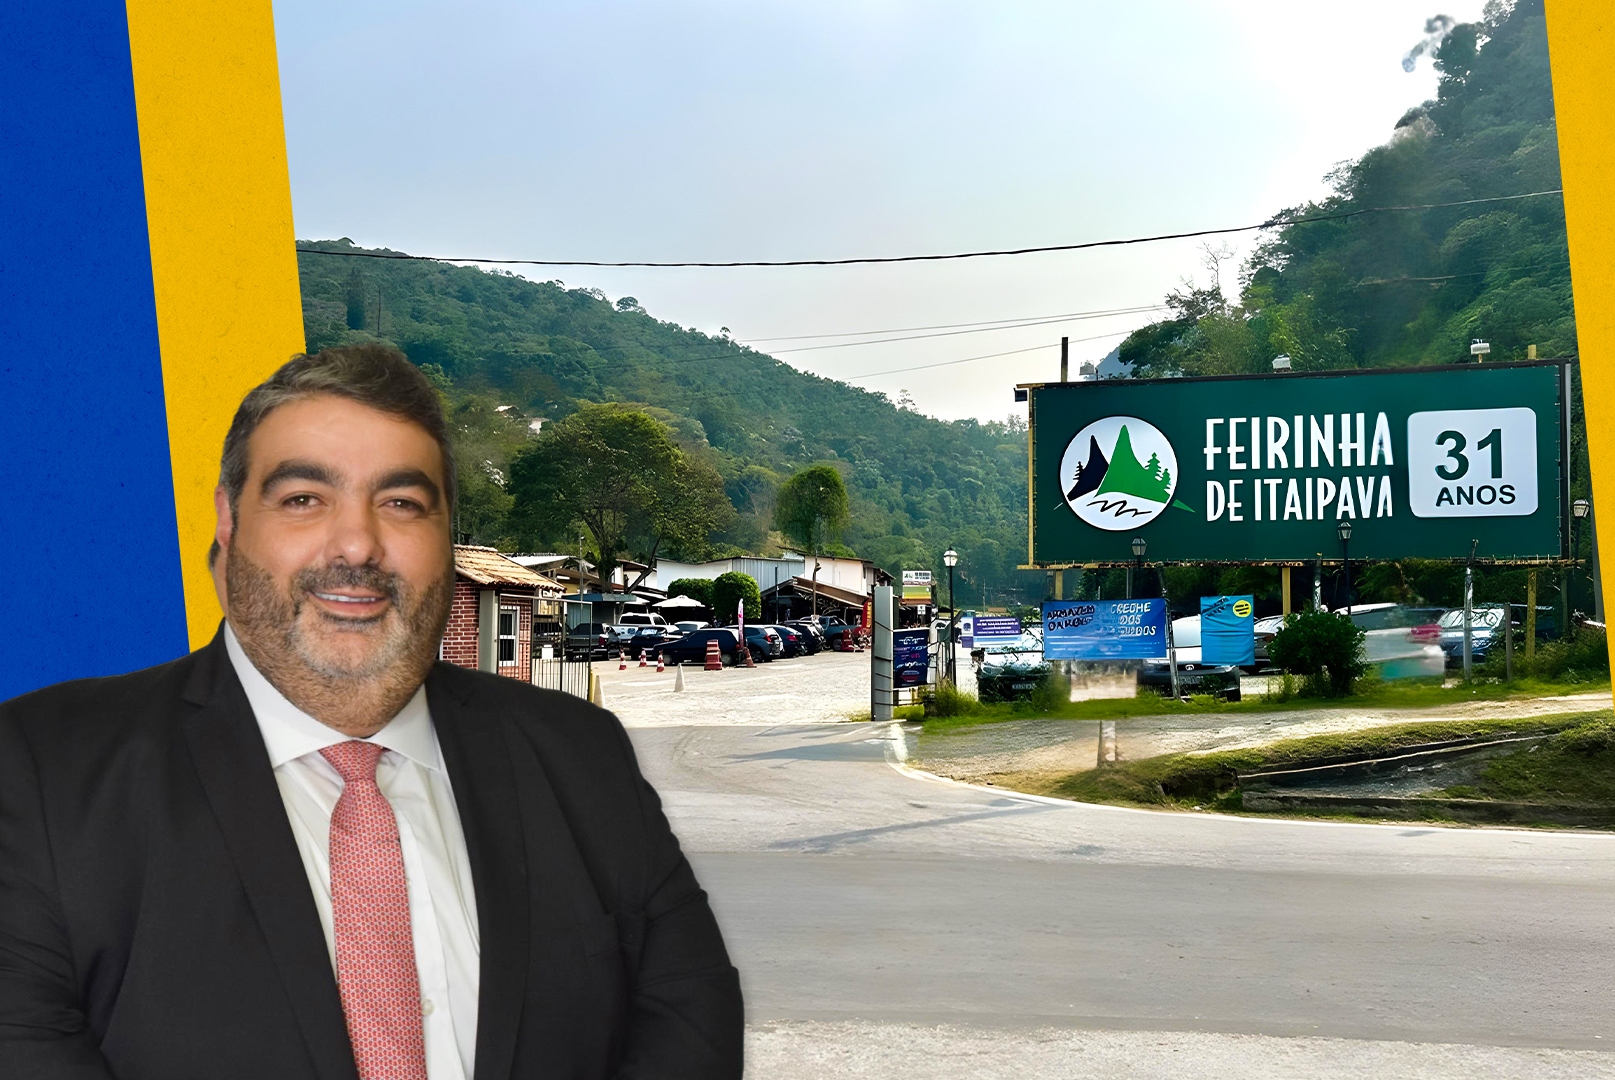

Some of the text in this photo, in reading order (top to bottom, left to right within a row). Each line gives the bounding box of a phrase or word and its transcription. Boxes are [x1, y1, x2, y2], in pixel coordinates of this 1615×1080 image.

[1204, 411, 1394, 470] FEIRINHA
[1434, 428, 1505, 480] 31
[1206, 475, 1393, 522] DE ITAIPAVA
[1435, 484, 1516, 507] ANOS
